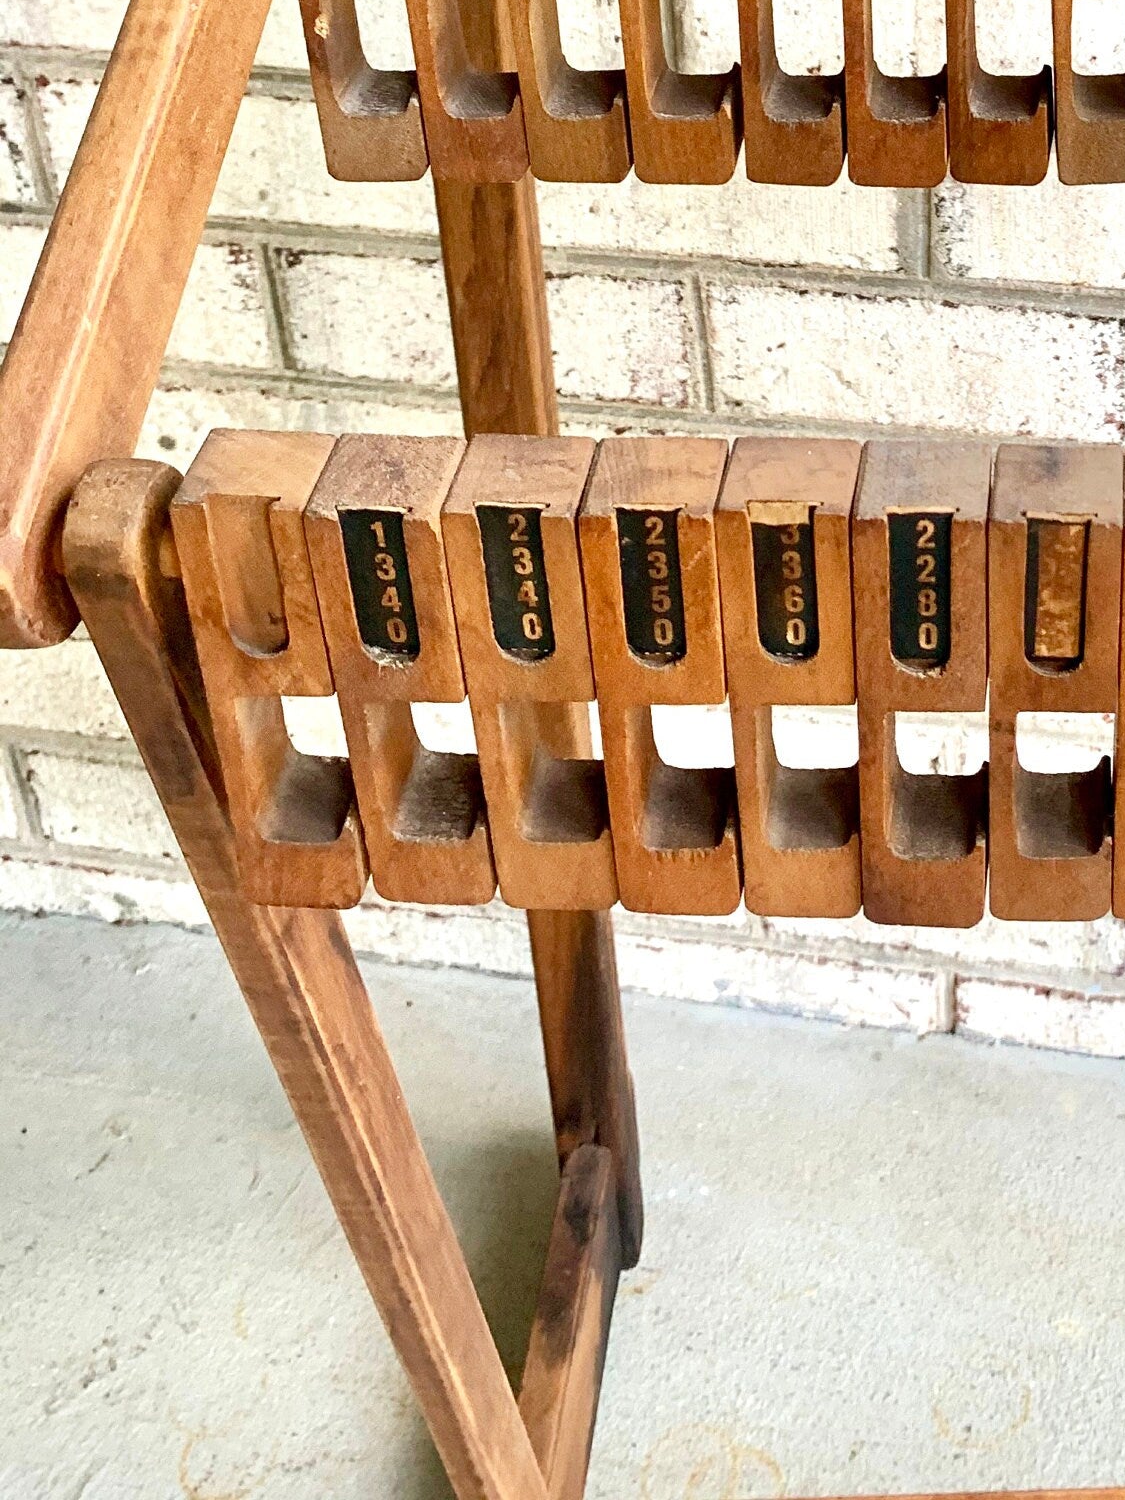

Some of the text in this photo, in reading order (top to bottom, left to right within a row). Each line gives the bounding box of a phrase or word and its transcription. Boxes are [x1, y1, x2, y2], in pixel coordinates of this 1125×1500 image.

[370, 520, 409, 644] 1340
[507, 513, 544, 641] 2340
[644, 515, 675, 647] 2350
[915, 519, 939, 651] 2280
